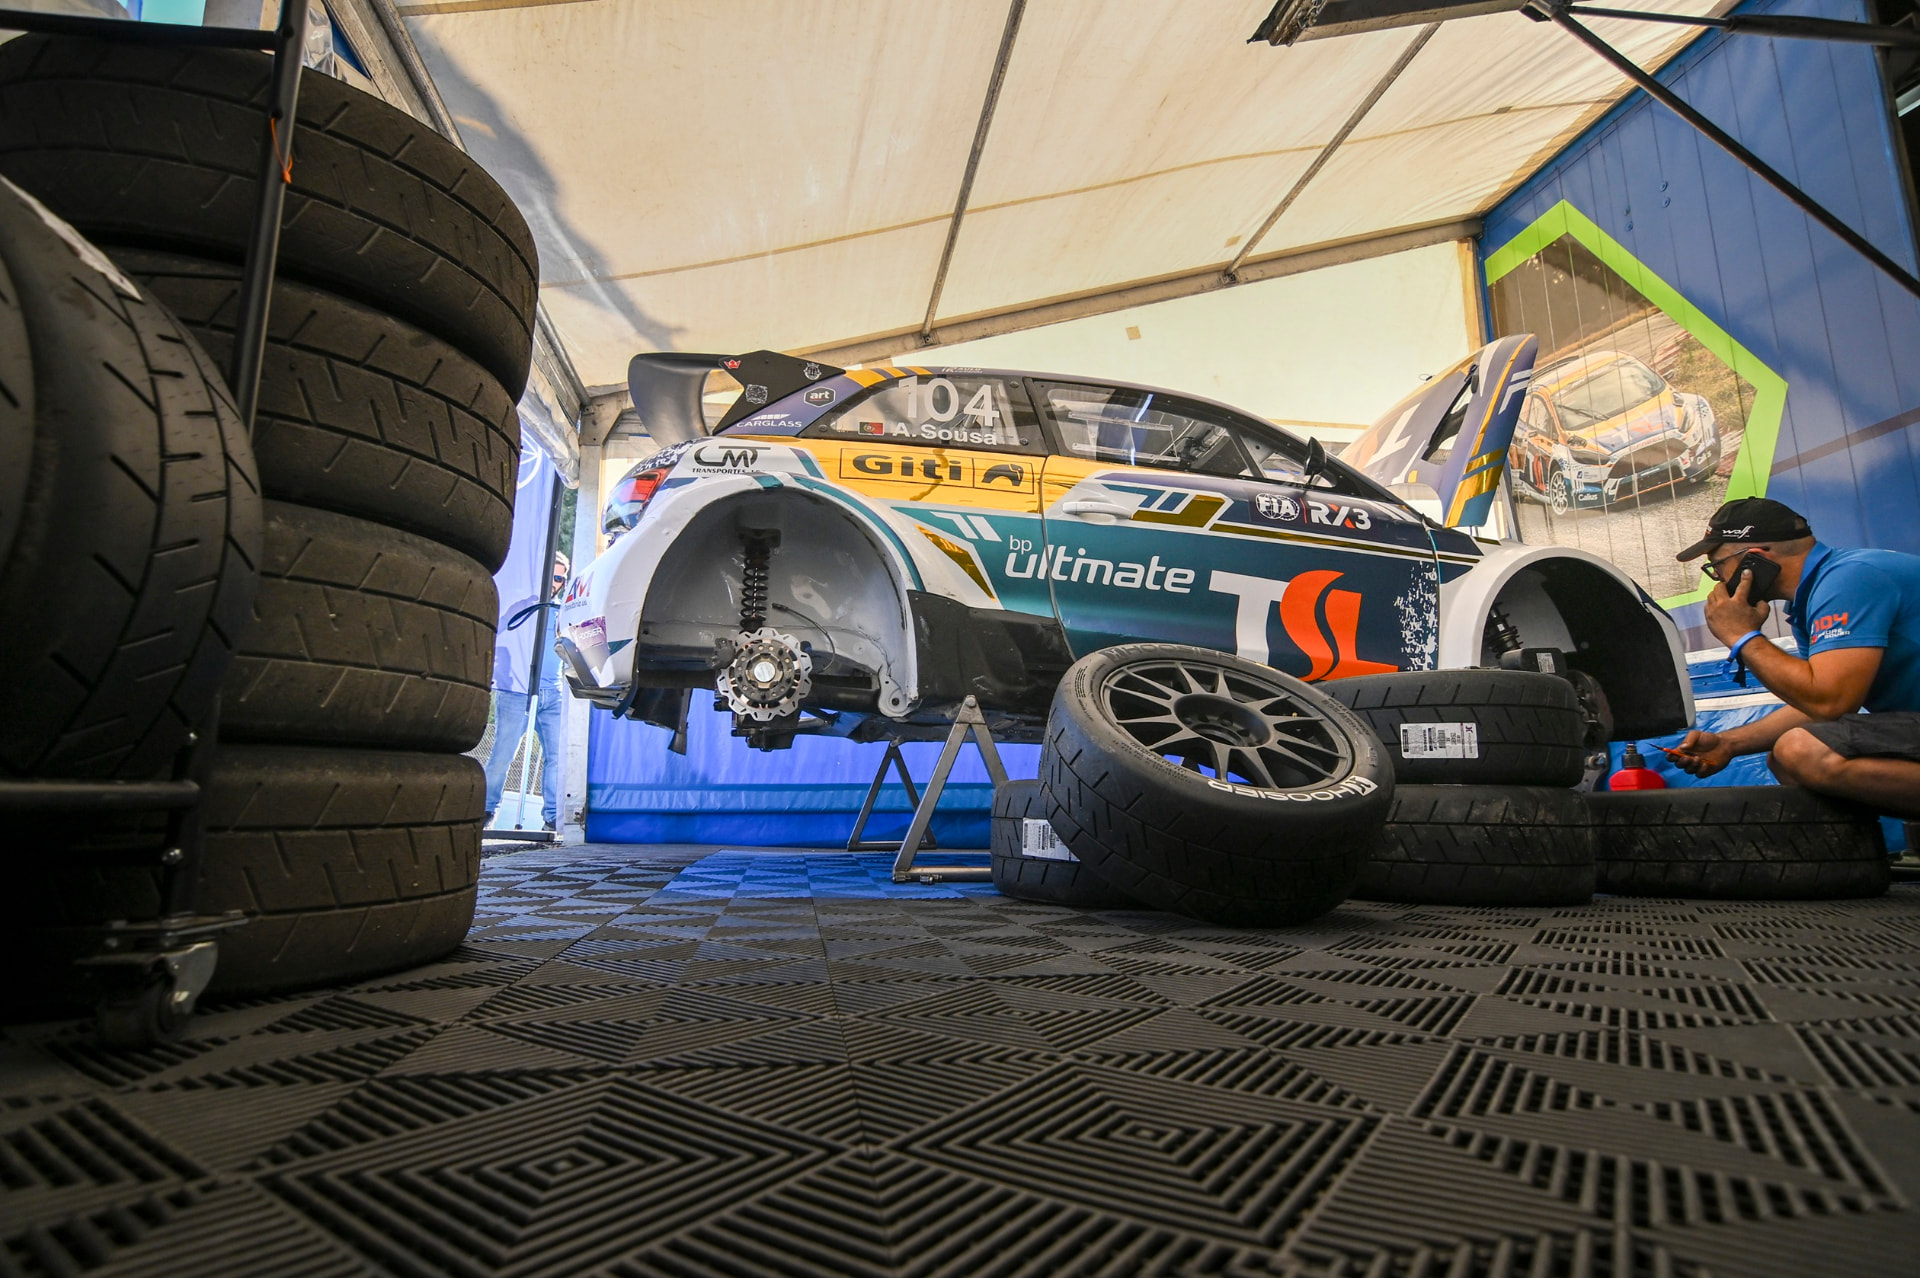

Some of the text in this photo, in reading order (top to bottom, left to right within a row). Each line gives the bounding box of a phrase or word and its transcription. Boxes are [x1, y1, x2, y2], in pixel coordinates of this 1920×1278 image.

[809, 390, 830, 400] art
[898, 375, 1000, 427] 104
[736, 420, 802, 428] CARGLASS
[892, 422, 998, 446] A. Sousa
[852, 454, 962, 481] Giti
[1259, 495, 1296, 517] FIA
[1009, 535, 1033, 555] bp
[1004, 543, 1196, 594] ultimate
[1814, 612, 1849, 633] 104
[1207, 779, 1356, 802] HOOSIER
